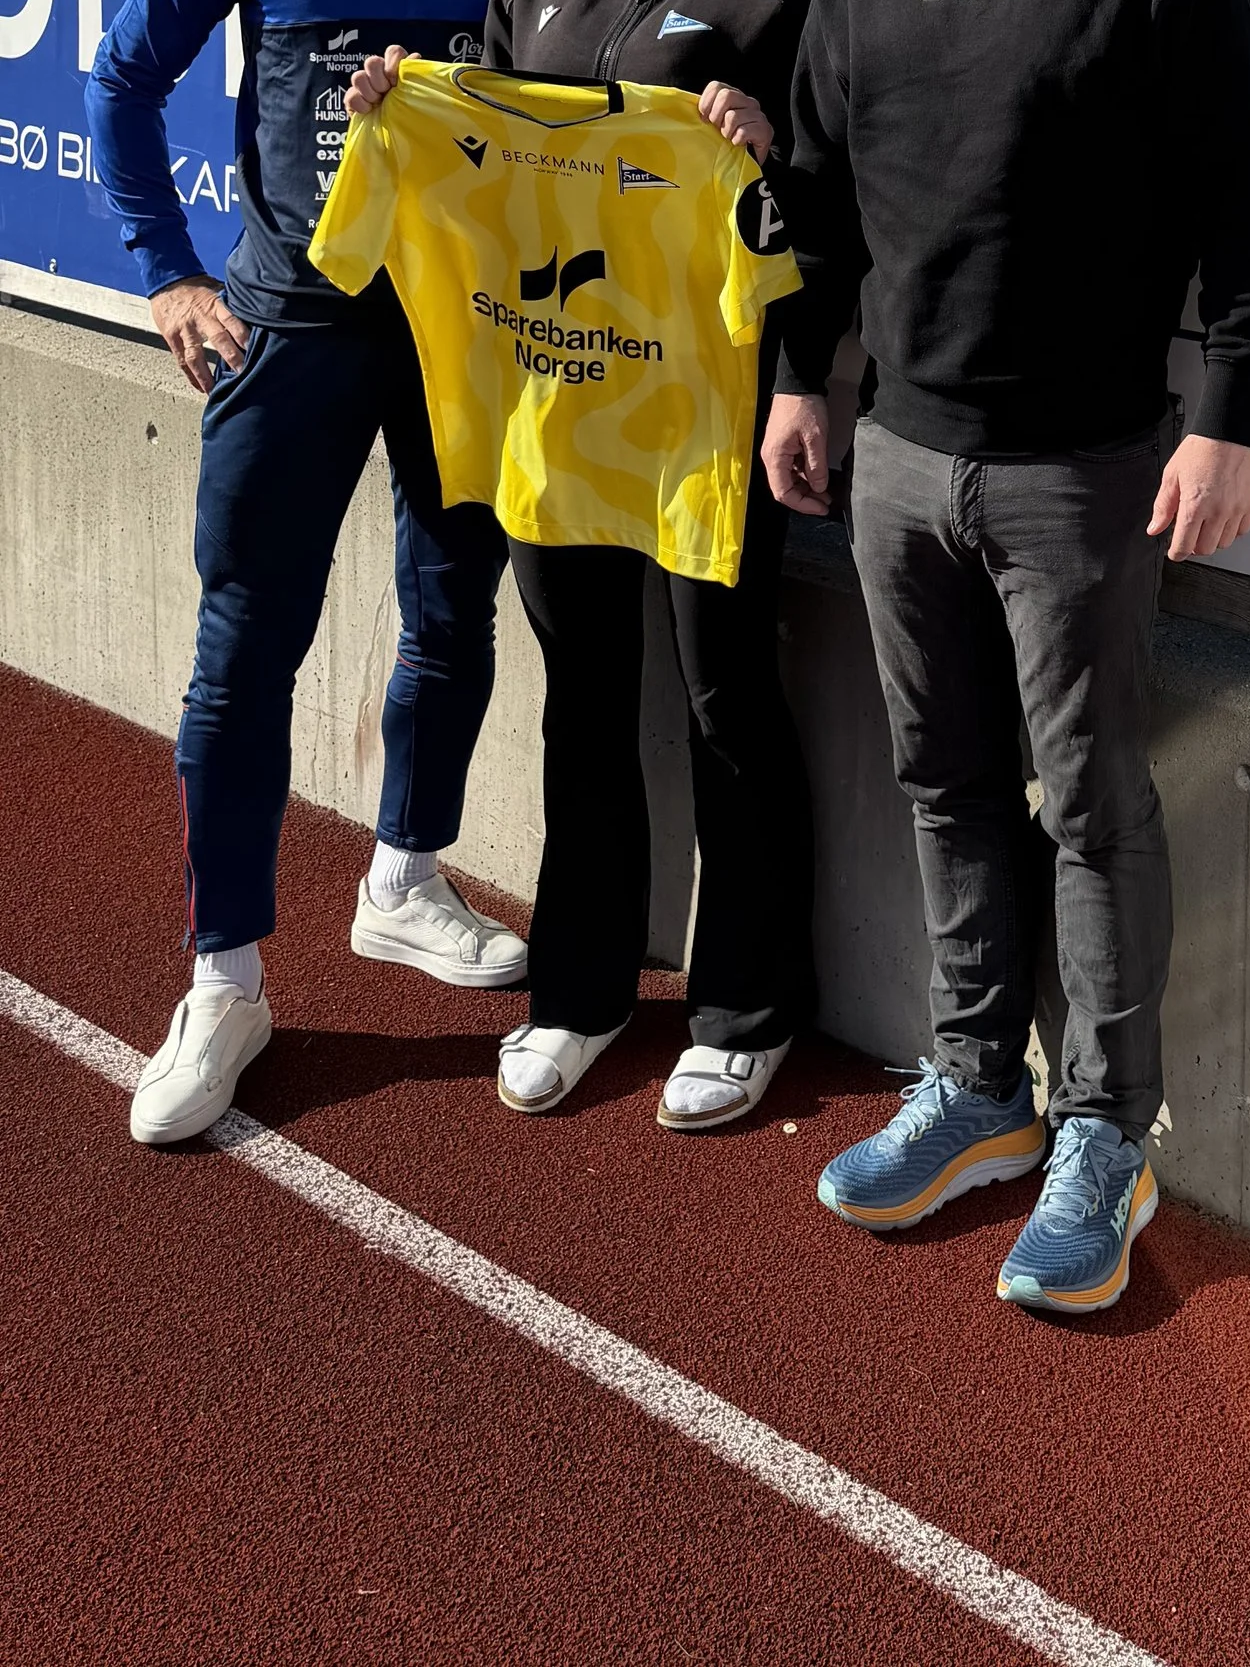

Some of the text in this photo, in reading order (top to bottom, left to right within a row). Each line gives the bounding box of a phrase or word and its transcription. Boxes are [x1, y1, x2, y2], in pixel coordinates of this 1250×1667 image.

[326, 62, 359, 73] Norge
[502, 149, 605, 175] BECKMANN
[472, 291, 663, 362] Sparebanken
[515, 339, 606, 384] Norge
